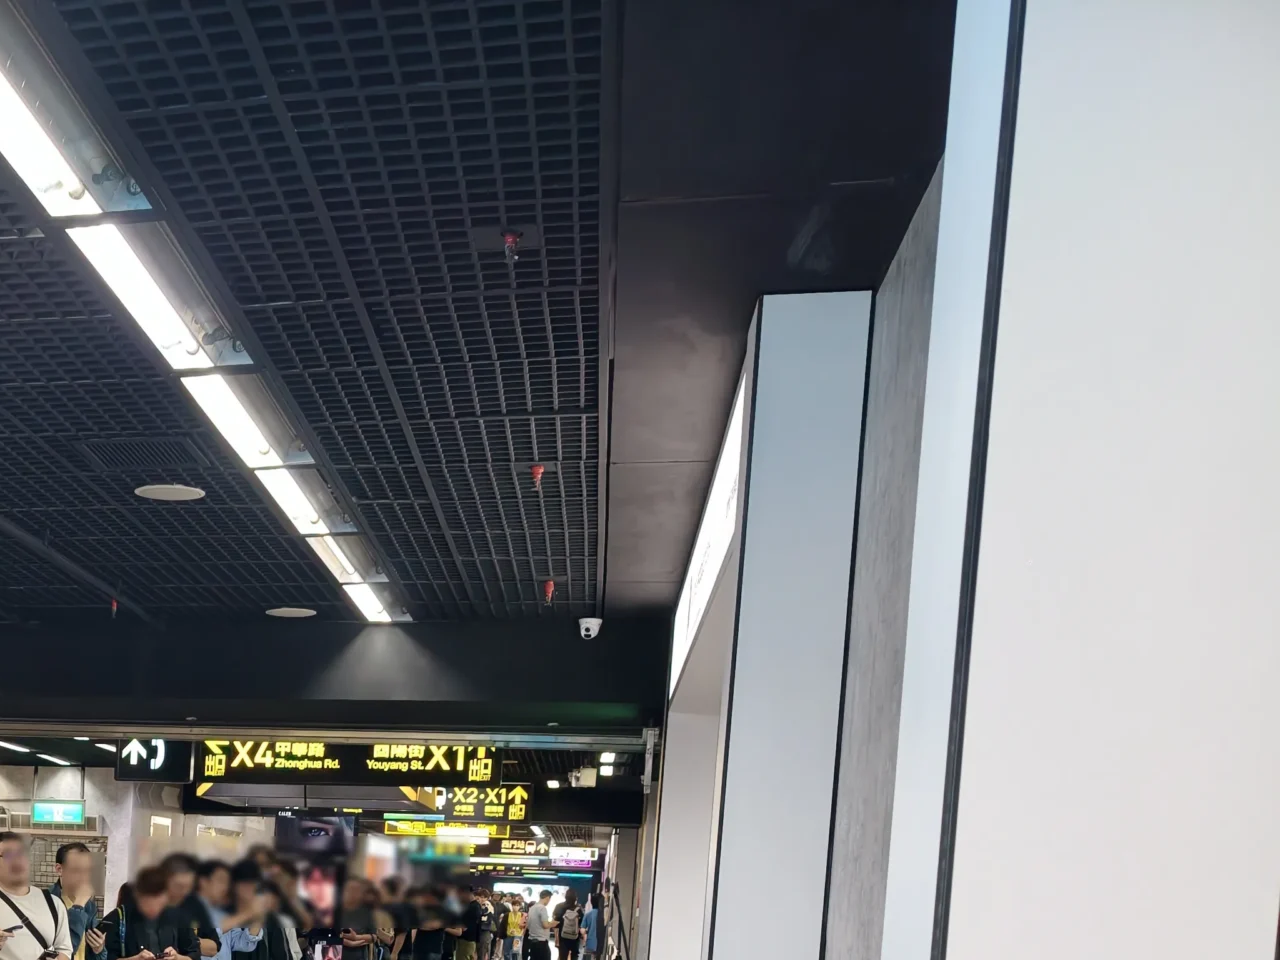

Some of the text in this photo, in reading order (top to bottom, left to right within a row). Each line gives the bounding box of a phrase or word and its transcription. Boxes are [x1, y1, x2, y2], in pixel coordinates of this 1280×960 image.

[230, 741, 274, 768] X4
[425, 745, 465, 771] X1
[275, 758, 340, 770] Zhonghua Rd.
[366, 759, 425, 772] Youyang St.
[452, 787, 479, 804] X2
[484, 788, 507, 804] X1
